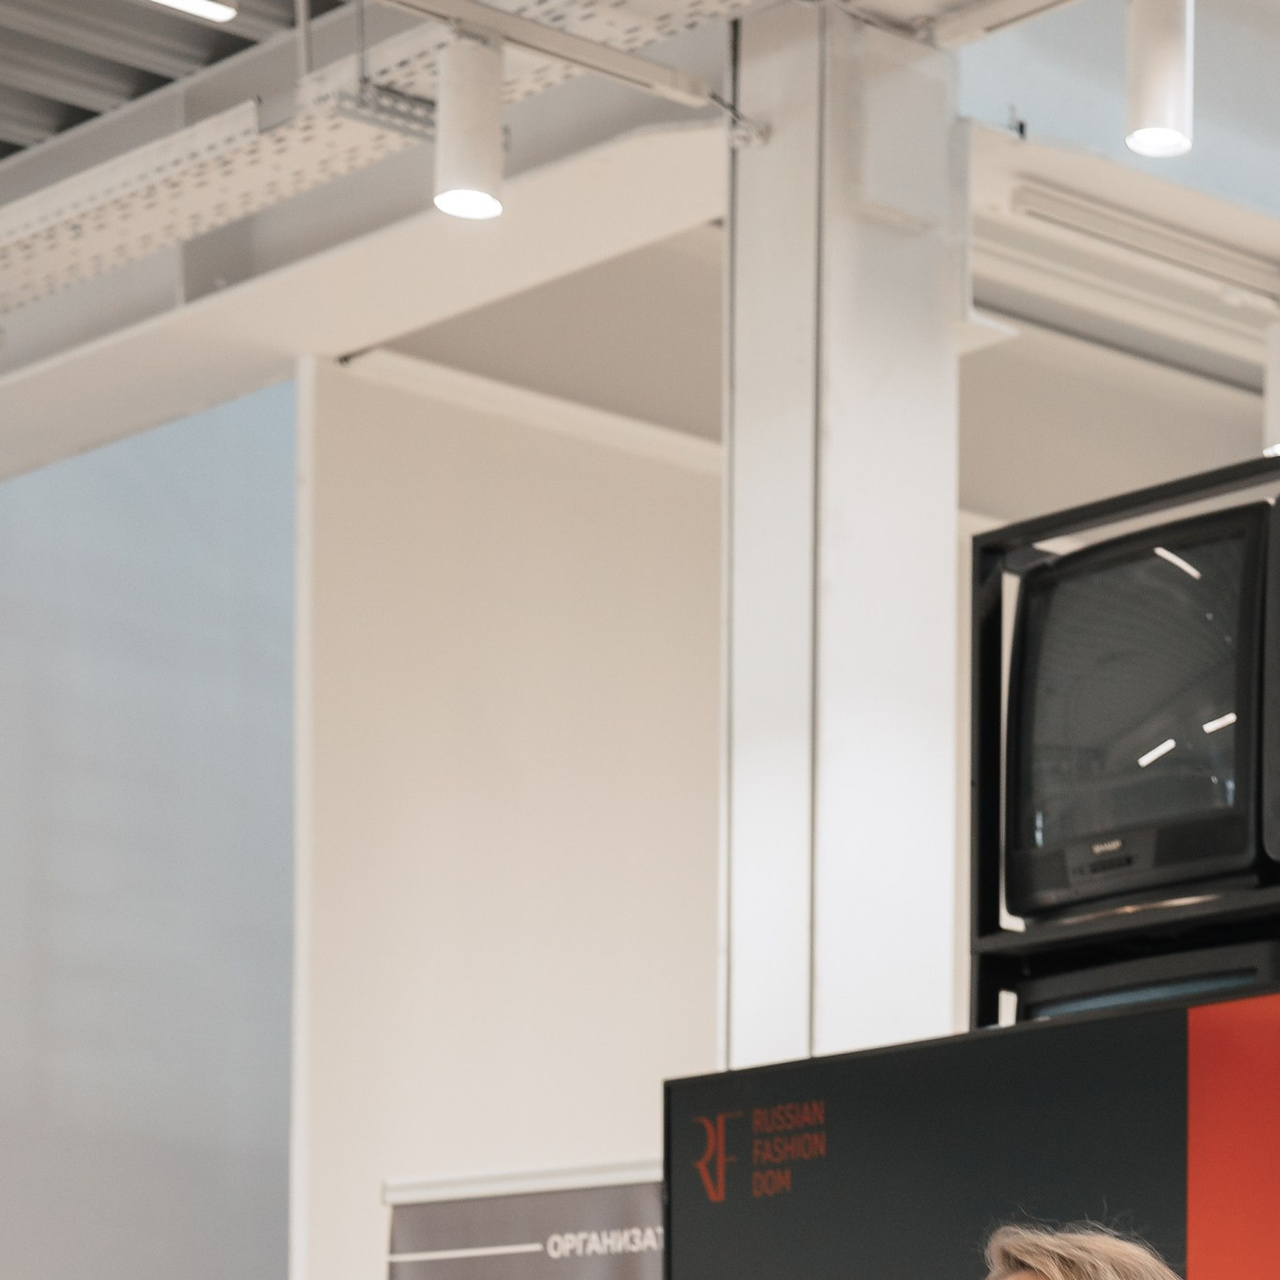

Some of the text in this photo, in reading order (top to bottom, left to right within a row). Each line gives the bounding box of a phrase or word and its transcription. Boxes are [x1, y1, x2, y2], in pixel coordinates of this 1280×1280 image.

[752, 1100, 826, 1133] RUSSIAN
[752, 1132, 827, 1165] FASHION
[752, 1168, 792, 1199] DOM
